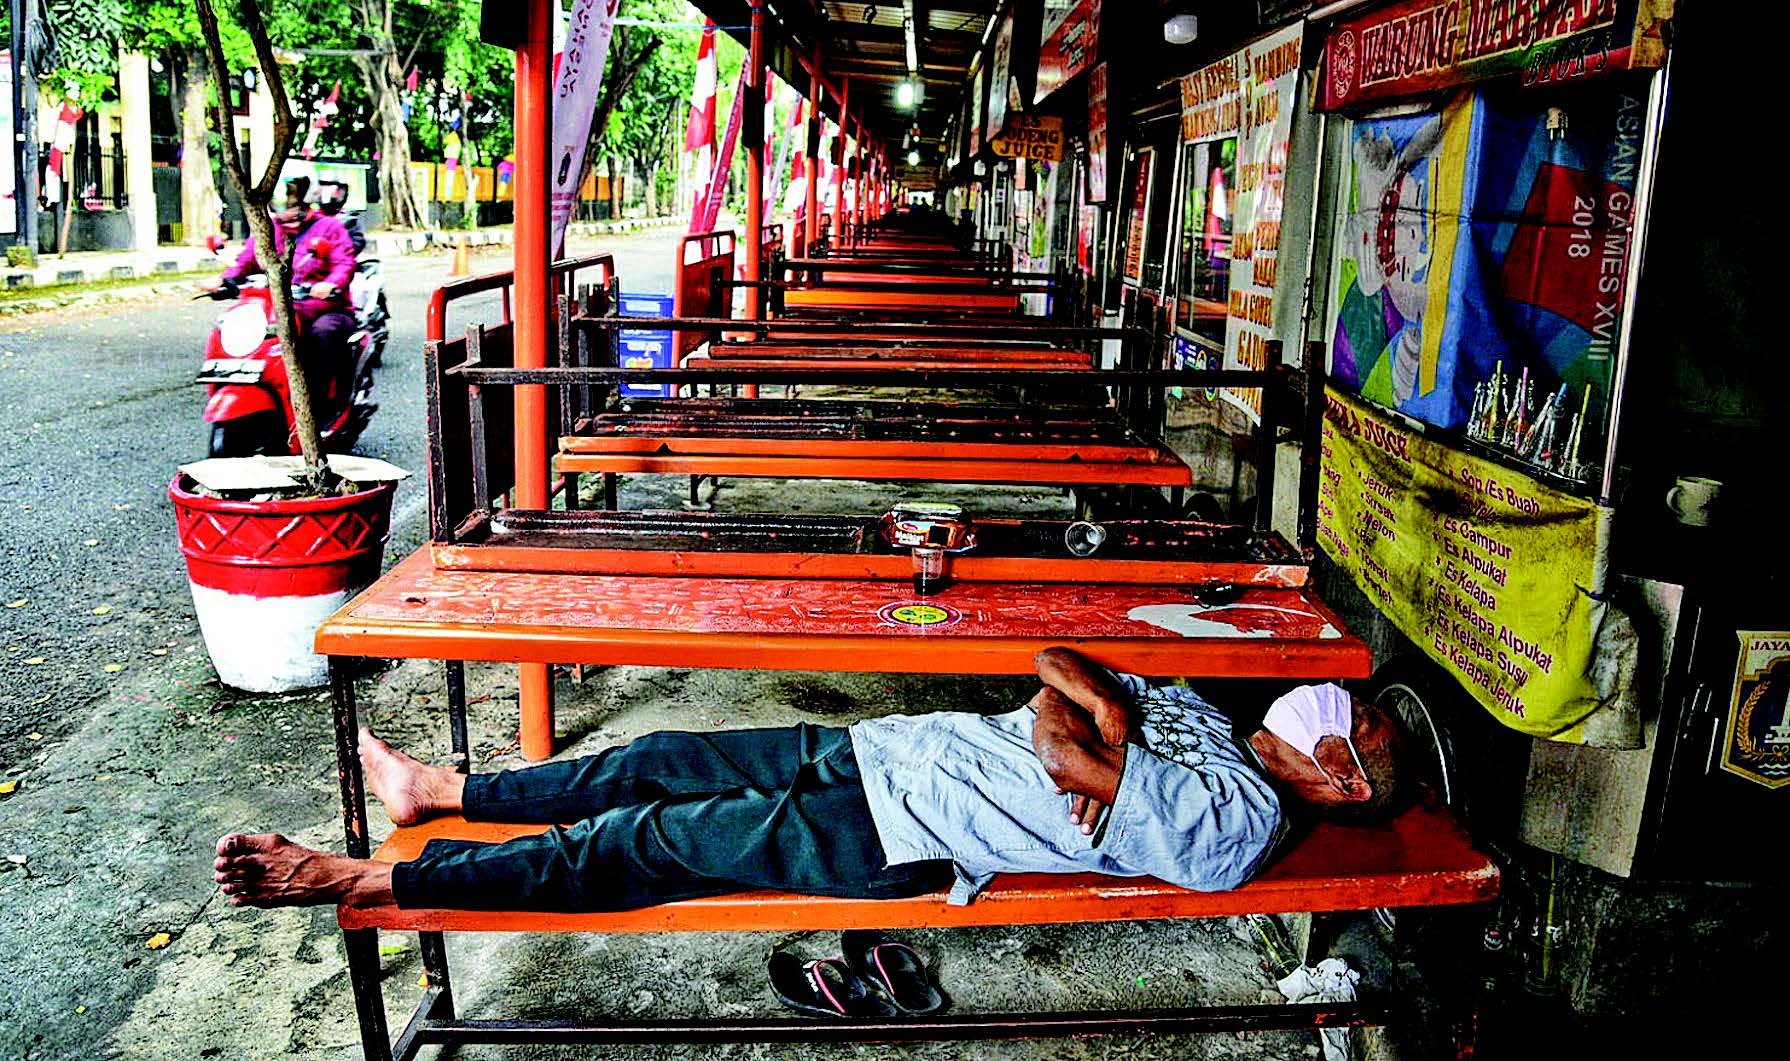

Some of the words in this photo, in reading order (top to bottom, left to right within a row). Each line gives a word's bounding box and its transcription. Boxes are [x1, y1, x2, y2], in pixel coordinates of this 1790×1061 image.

[1360, 1, 1463, 88] WARUNG
[1000, 141, 1055, 159] JUICE
[1611, 94, 1640, 182] ASIAN
[1567, 196, 1596, 259] 2018
[1598, 191, 1631, 293] GAMES
[1587, 301, 1618, 361] XVIII
[1364, 417, 1413, 464] JUICE
[1364, 473, 1395, 502] Jeruk
[1506, 486, 1541, 517] Buah
[1363, 510, 1396, 542] Melon
[1443, 514, 1458, 533] Es
[1460, 521, 1514, 560] Campur
[1444, 536, 1459, 558] Es
[1461, 546, 1507, 587] Alpukat
[1445, 560, 1458, 582] Es
[1458, 569, 1496, 611] Kelapa
[1436, 608, 1450, 632] Es
[1451, 619, 1494, 664] Kelapa
[1497, 651, 1529, 688] Susu
[1437, 583, 1452, 607] Es
[1454, 594, 1495, 638] Kelapa
[1498, 624, 1552, 674] Alpukat
[1434, 632, 1448, 656] Es
[1449, 645, 1491, 688] Kelapa
[1490, 678, 1525, 719] Jeruk
